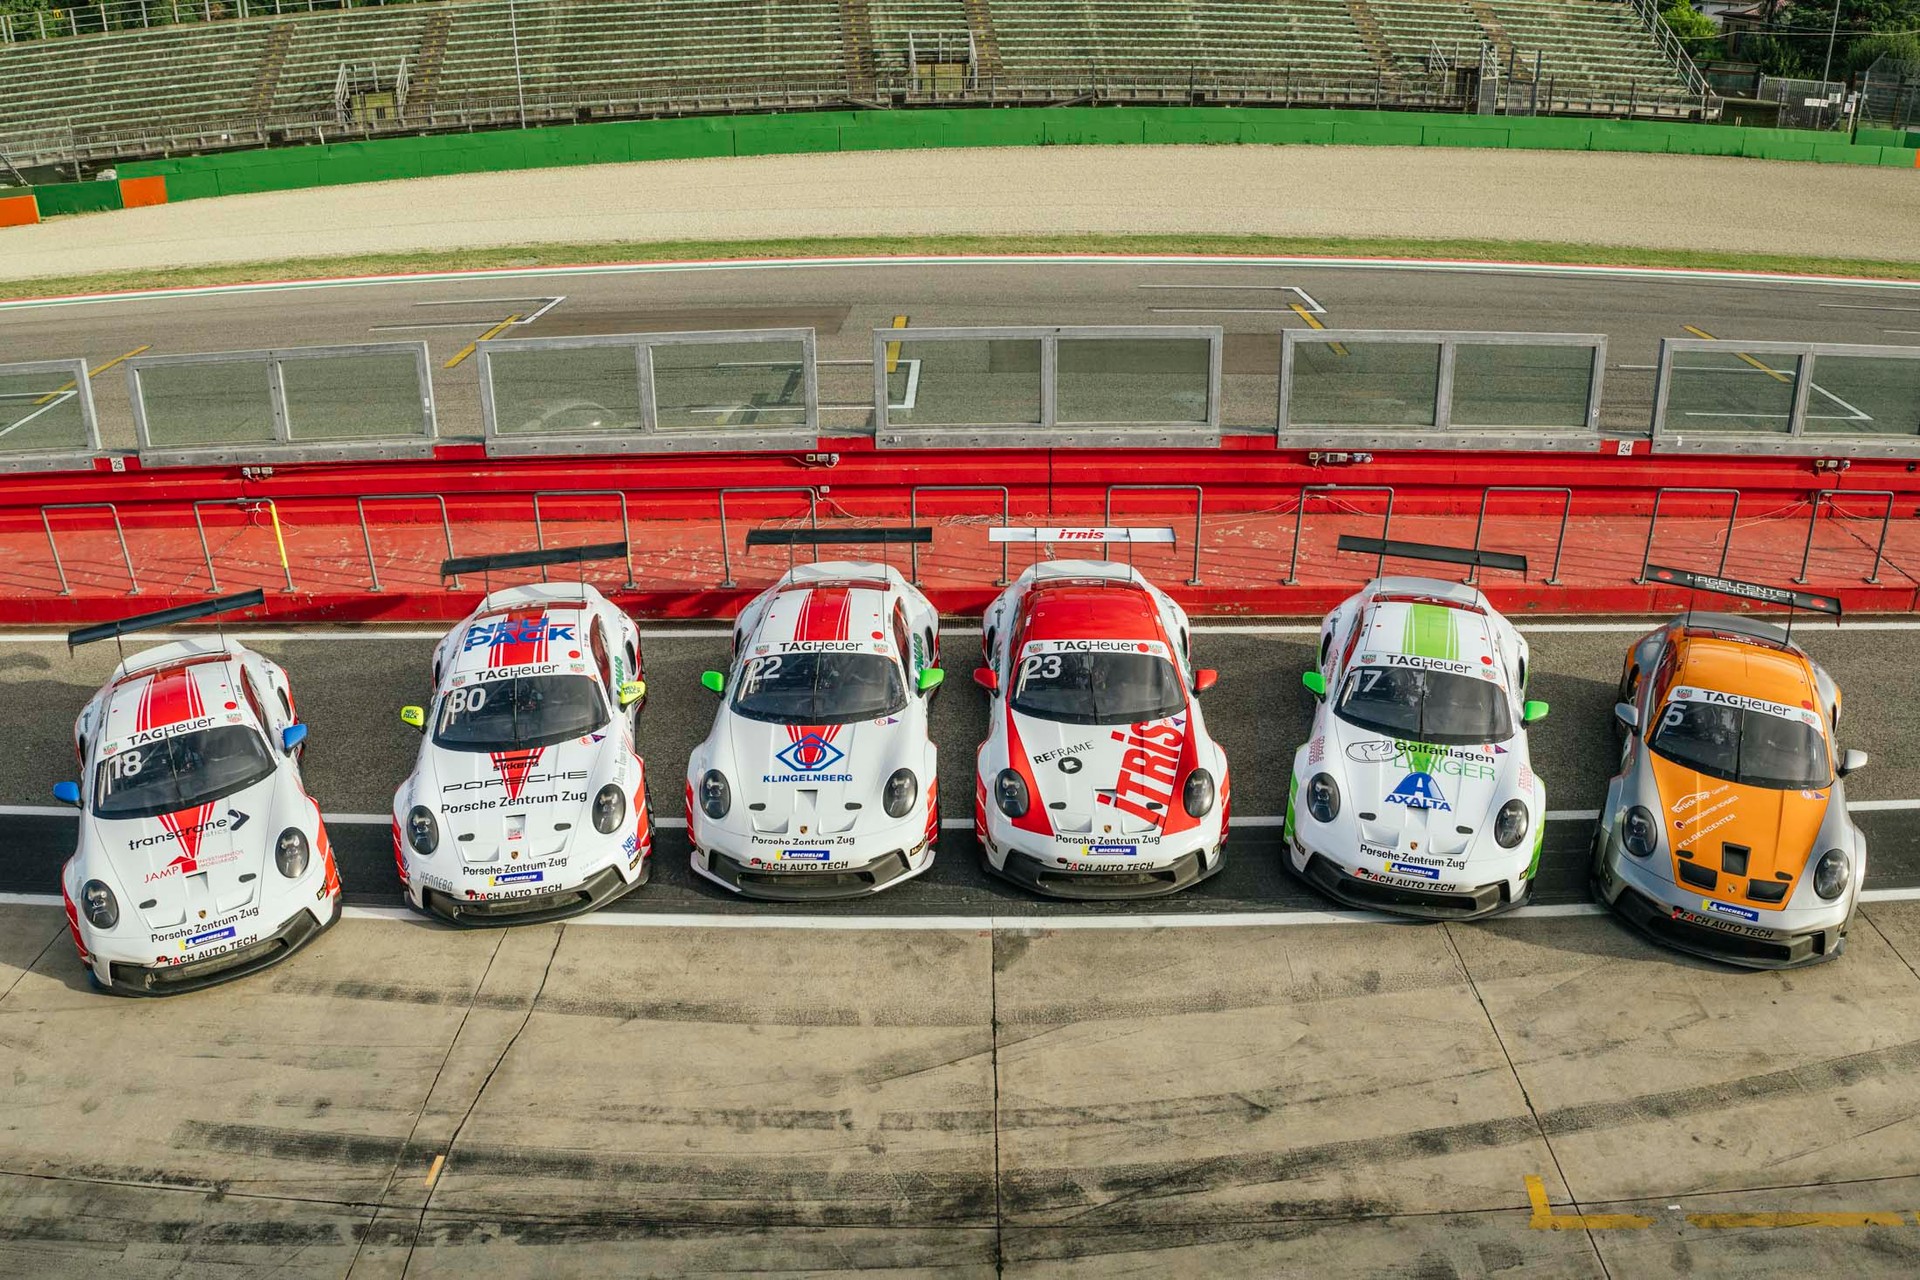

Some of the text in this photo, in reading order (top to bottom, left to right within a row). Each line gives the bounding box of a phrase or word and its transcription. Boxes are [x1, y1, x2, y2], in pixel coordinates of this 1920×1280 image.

[467, 617, 550, 638] NEU
[464, 627, 575, 652] PACK
[1026, 655, 1062, 679] 23
[1351, 669, 1383, 693] 17
[1033, 740, 1095, 765] REFRAME
[1394, 741, 1495, 764] Golfanlagen
[109, 750, 142, 780] 18
[442, 770, 588, 793] PORSCHE
[762, 774, 853, 783] KLINGELNBERG
[440, 790, 588, 815] Porsche Zentrum Zug
[1384, 793, 1452, 812] AXALTA
[128, 817, 228, 851] transcrane
[751, 834, 856, 847] Porsche Zentrum Zug
[1055, 833, 1161, 846] Porsche Zentrum Zug
[790, 851, 825, 859] MICHELIN
[1359, 843, 1466, 871] Porsche Zentrum Zug
[144, 865, 179, 883] JAMP
[462, 864, 502, 877] Porsche
[504, 860, 548, 875] Zentrum
[549, 857, 568, 868] Zug
[761, 860, 849, 872] FACH AUTO TECH
[1065, 861, 1155, 872] FACH AUTO TECH
[1399, 866, 1434, 876] MICHELIN
[503, 874, 538, 883] MICHELIN
[1366, 871, 1457, 893] FACH AUTO TECH
[475, 883, 563, 901] FACH AUTO TECH
[1719, 905, 1754, 918] MICHELIN
[151, 906, 260, 943] Porsche Zentrum Zug
[1680, 911, 1774, 939] FACH AUTO TECH
[195, 930, 230, 945] MICHELIN
[167, 933, 258, 966] FACH AUTO TECH
